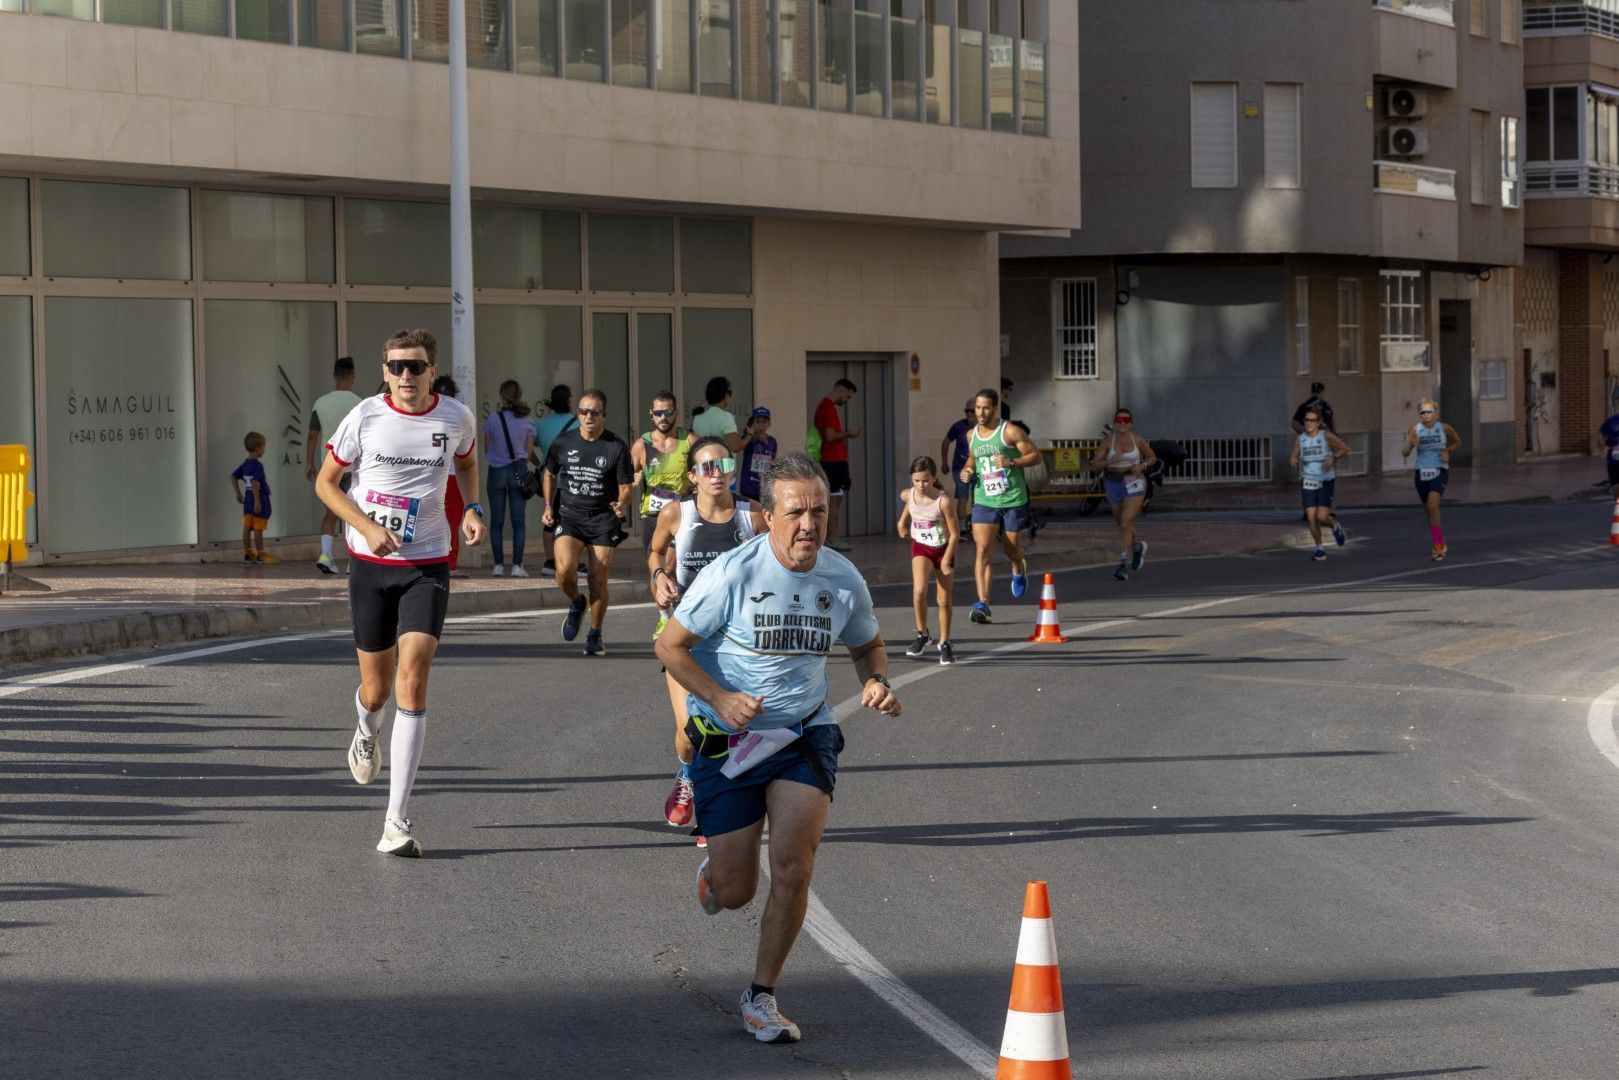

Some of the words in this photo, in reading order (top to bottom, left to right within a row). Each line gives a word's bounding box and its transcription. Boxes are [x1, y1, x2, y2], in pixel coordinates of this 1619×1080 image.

[68, 395, 175, 415] SAMAGUIL
[69, 429, 96, 444] (+34)
[100, 429, 123, 442] 606
[129, 427, 150, 440] 961
[155, 427, 175, 440] 016
[375, 453, 445, 467] tempersouls
[985, 482, 1002, 492] 221
[754, 613, 781, 627] CLUB
[783, 613, 831, 631] ATLETISMO
[753, 628, 831, 652] TORREVIEJA
